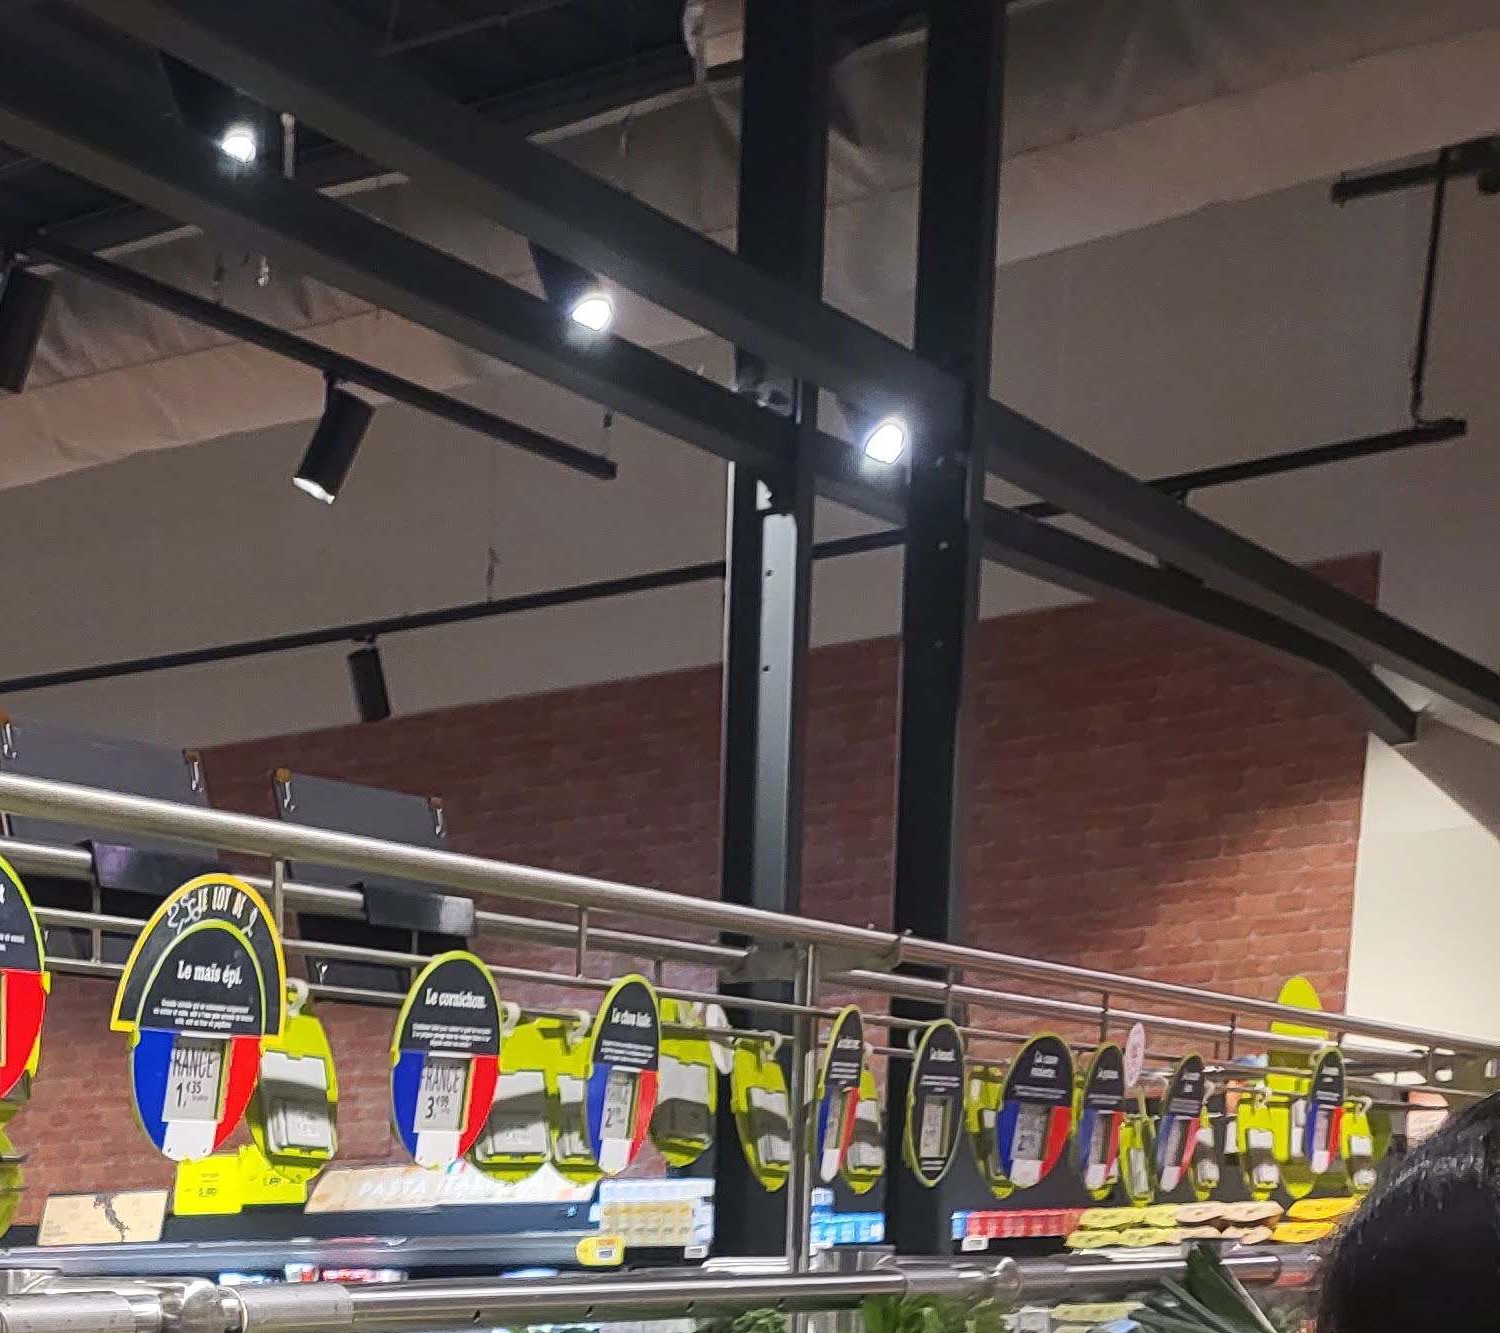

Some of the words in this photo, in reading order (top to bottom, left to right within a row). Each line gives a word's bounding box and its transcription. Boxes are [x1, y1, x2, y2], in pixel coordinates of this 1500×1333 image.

[177, 959, 192, 979] Le
[193, 962, 220, 982] maïs
[425, 987, 438, 1005] Le
[172, 1047, 213, 1079] RANCE
